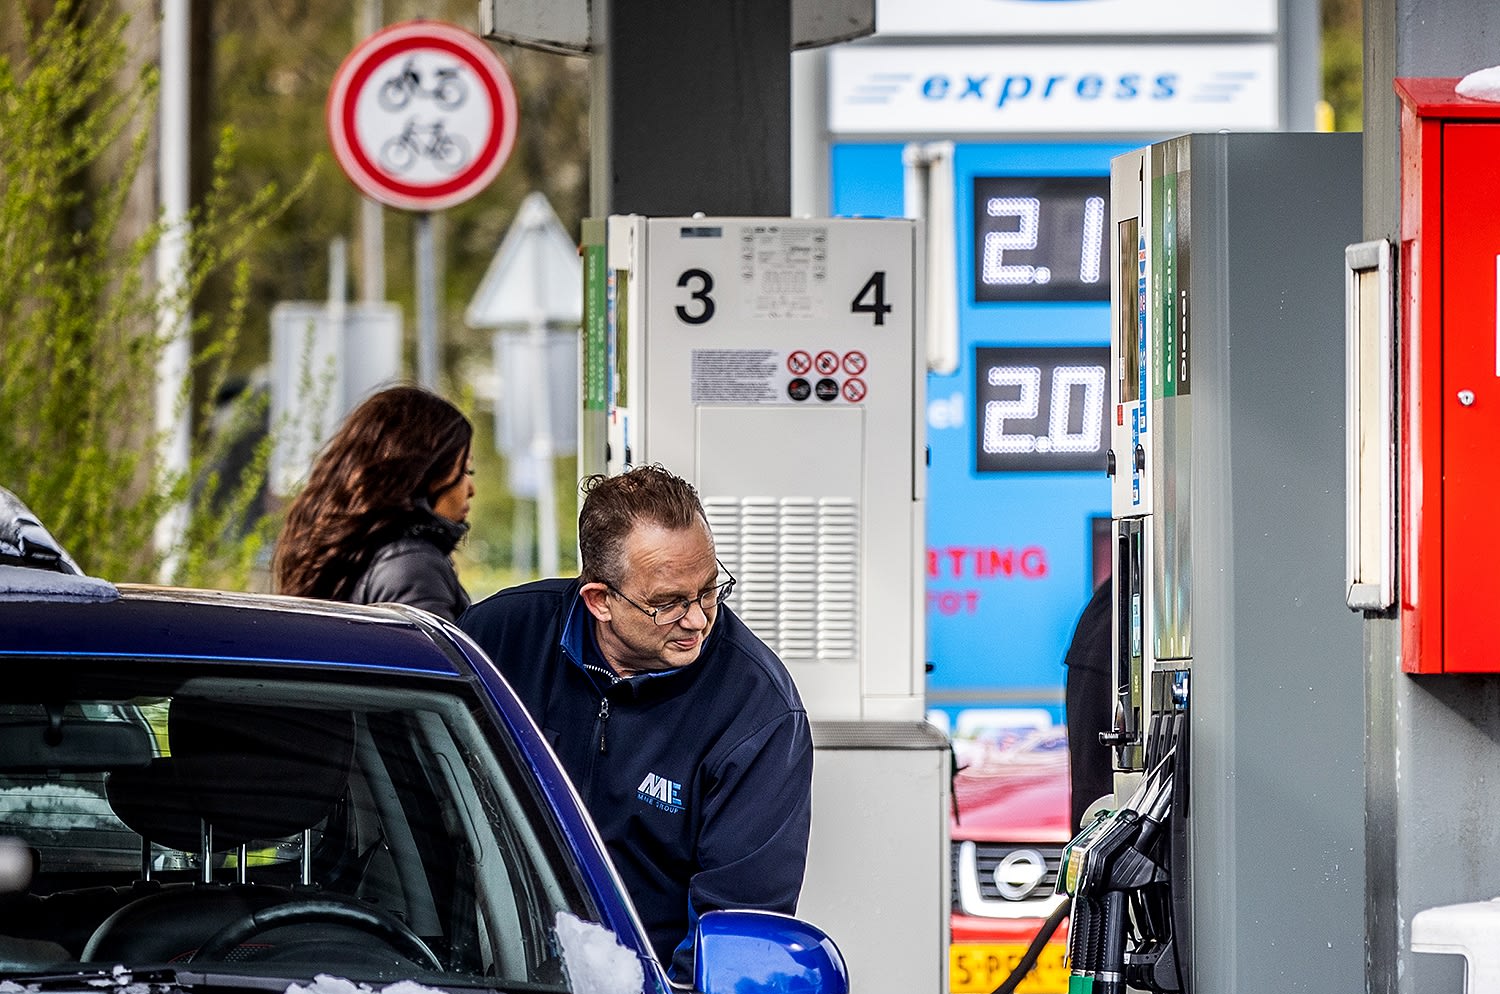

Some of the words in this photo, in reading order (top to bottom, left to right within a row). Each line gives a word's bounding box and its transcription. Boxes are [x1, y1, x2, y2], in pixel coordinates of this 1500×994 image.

[920, 73, 1181, 109] express
[674, 267, 716, 326] 3
[850, 270, 893, 326] 4
[982, 365, 1107, 453] 2.0
